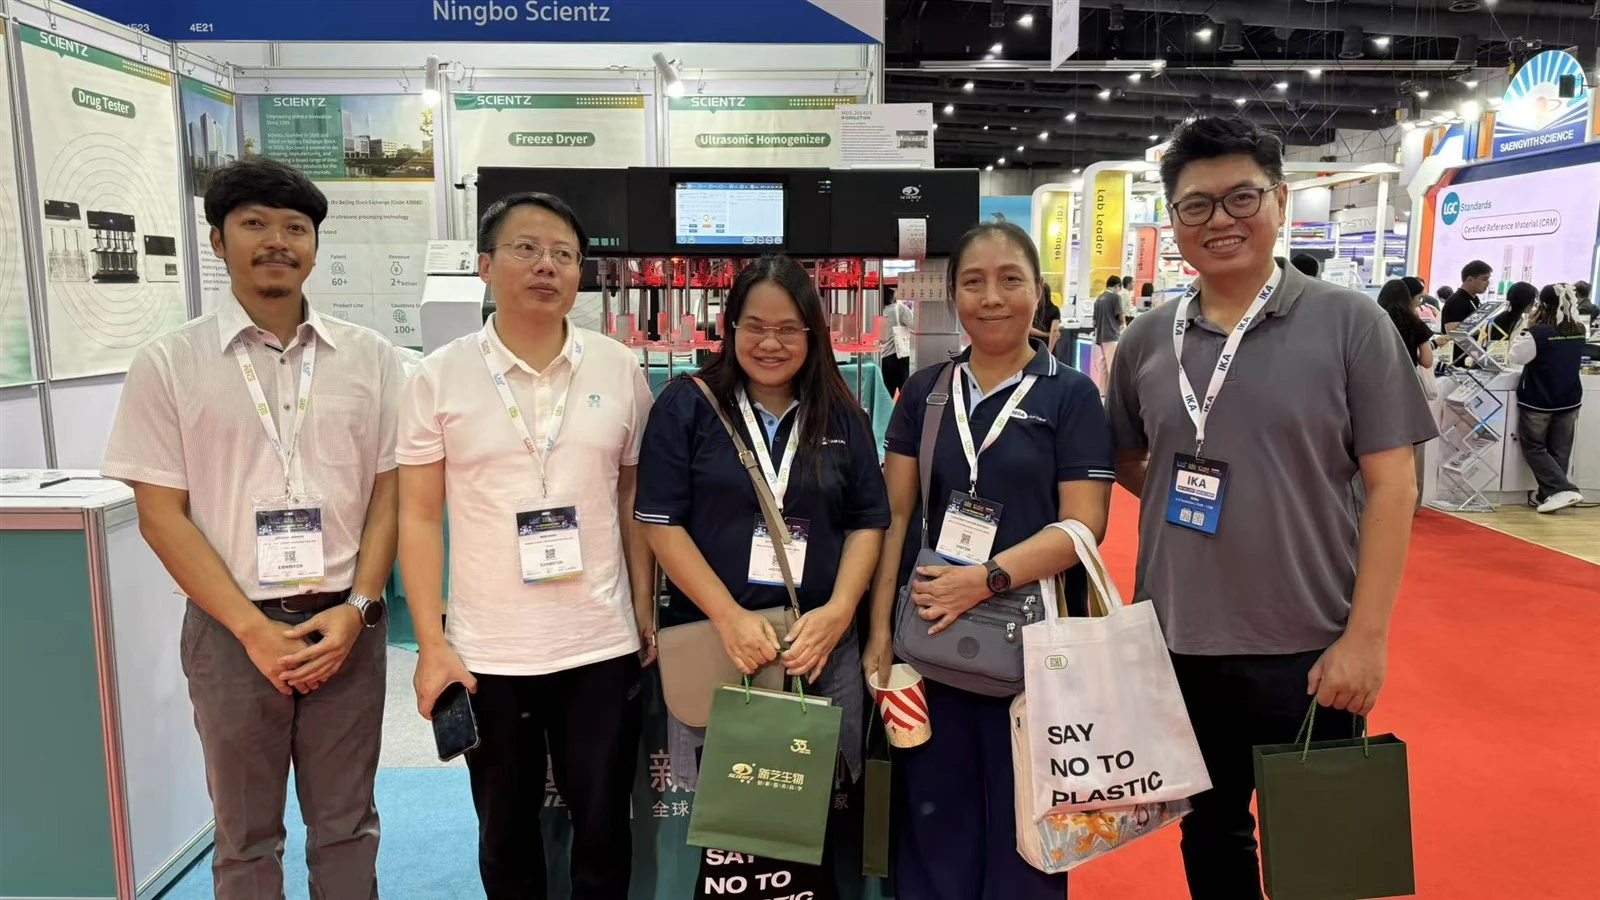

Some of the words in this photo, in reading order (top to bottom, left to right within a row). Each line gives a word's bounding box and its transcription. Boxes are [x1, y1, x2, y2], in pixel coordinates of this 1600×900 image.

[433, 0, 518, 26] Ningbo
[526, 1, 611, 22] Scientz
[189, 23, 214, 32] 4E21
[40, 32, 89, 57] SCIENTZ
[78, 90, 101, 111] Drug
[102, 95, 130, 115] Tester
[273, 97, 327, 107] SCIENTZ
[477, 95, 532, 105] SCIENTZ
[691, 97, 746, 107] SCIENTZ
[515, 134, 554, 145] Freeze
[556, 134, 589, 147] Dryer
[700, 134, 754, 145] Ultrasonic
[756, 134, 826, 147] Homogenizer
[1500, 137, 1540, 153] SAENGVITH
[1540, 129, 1575, 145] SCIENCE
[1096, 188, 1106, 211] Lab
[1443, 201, 1459, 215] LGC
[1460, 199, 1493, 213] Standards
[1095, 213, 1105, 255] Leader
[1464, 223, 1487, 234] Certified
[1487, 221, 1514, 232] Reference
[1514, 218, 1539, 230] Material
[1539, 217, 1558, 229] (CRM)
[331, 278, 348, 286] 60+
[1258, 284, 1274, 300] IKA
[394, 325, 416, 334] 100+
[1175, 319, 1185, 336] IKA
[1236, 316, 1252, 331] IKA
[1217, 353, 1232, 372] IKA
[1185, 394, 1198, 412] IKA
[1203, 395, 1215, 413] IKA
[1187, 475, 1207, 489] IKA
[1047, 722, 1095, 745] SAY
[1051, 756, 1090, 778] NO
[1097, 750, 1135, 774] TO
[757, 767, 805, 786] 新芝生物
[1051, 770, 1164, 808] PLASTIC
[652, 799, 690, 818] 全球
[705, 847, 755, 866] SA
[704, 875, 748, 894] NO
[754, 870, 792, 891] TO
